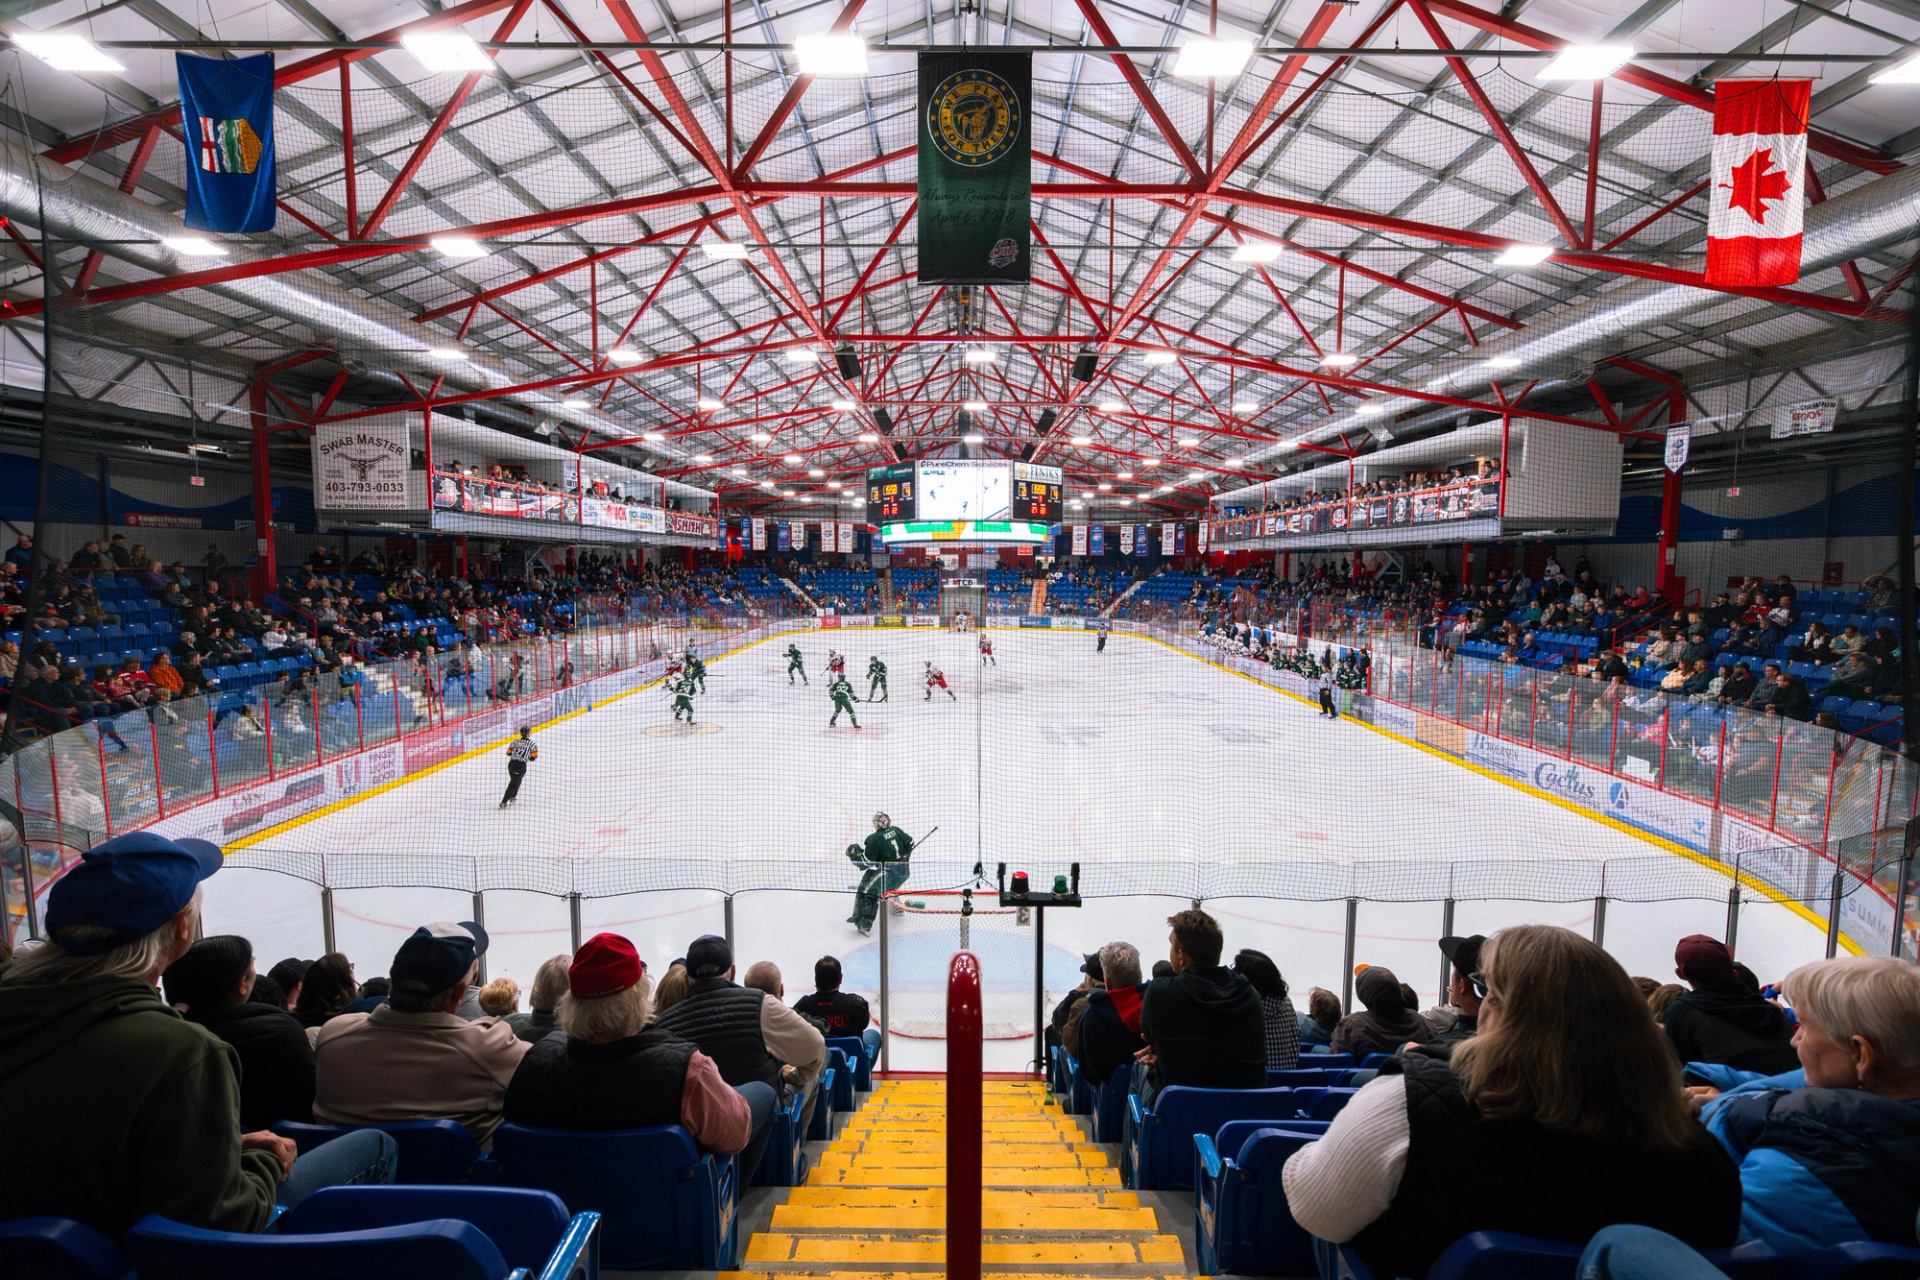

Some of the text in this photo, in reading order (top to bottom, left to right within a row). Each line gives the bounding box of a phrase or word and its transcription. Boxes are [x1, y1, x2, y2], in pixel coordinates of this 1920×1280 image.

[974, 83, 1006, 110] PLAY
[943, 124, 1006, 152] FOR THEM
[320, 434, 404, 456] SWAB MASTER
[325, 482, 404, 492] 403-793-0033
[1534, 762, 1596, 799] Cactus
